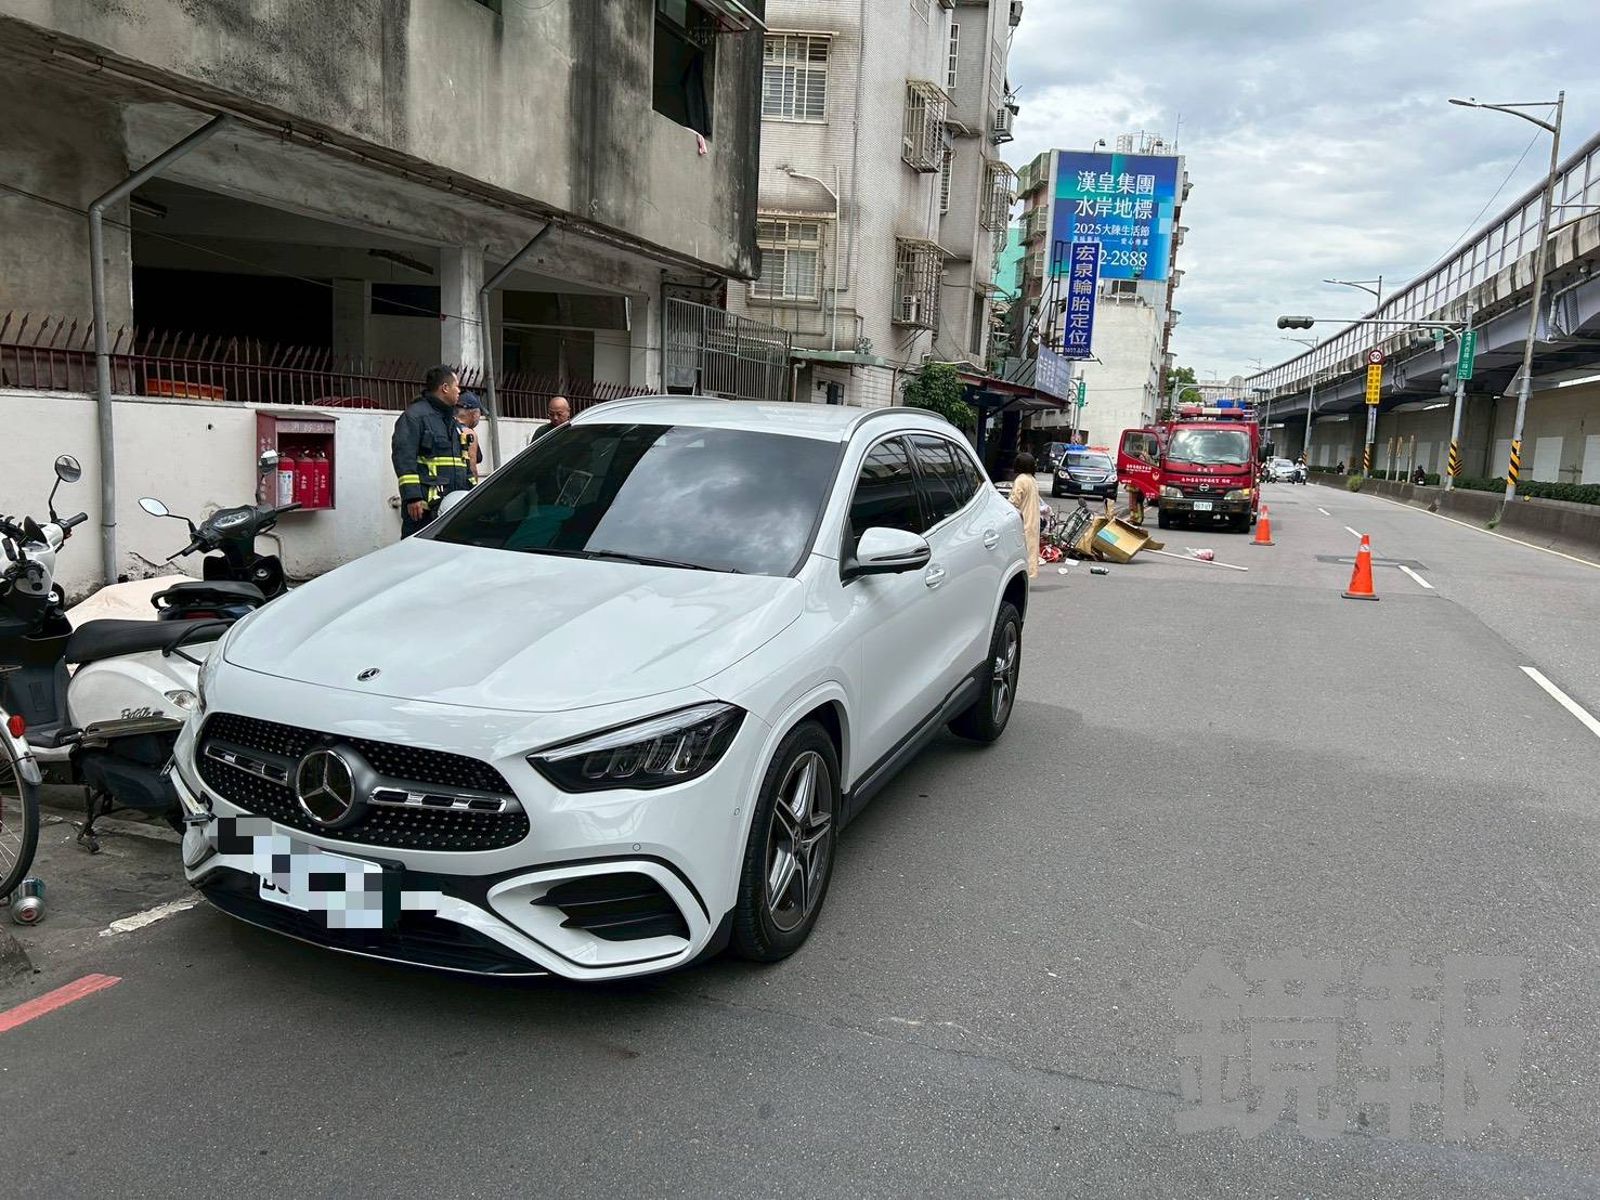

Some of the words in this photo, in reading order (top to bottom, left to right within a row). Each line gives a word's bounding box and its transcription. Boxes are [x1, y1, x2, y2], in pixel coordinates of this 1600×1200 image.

[1078, 170, 1155, 196] 漢皇集團
[1074, 195, 1153, 219] 水岸地標
[1068, 245, 1096, 346] 宏泉輪胎定位
